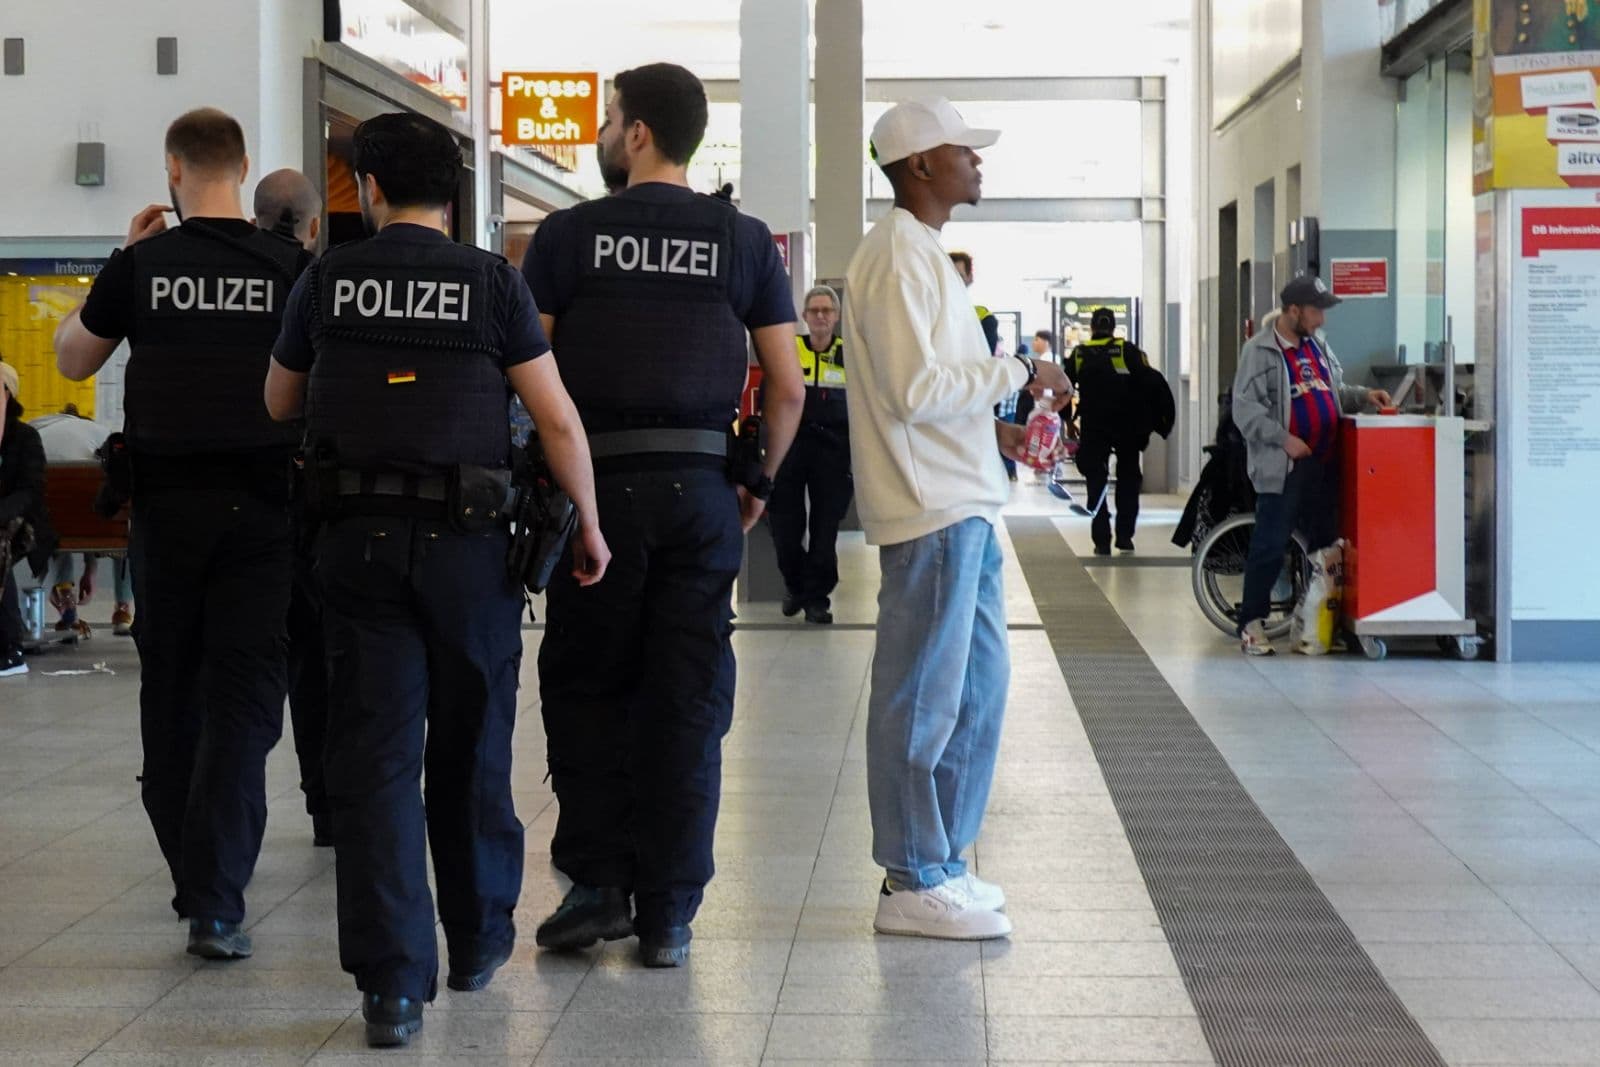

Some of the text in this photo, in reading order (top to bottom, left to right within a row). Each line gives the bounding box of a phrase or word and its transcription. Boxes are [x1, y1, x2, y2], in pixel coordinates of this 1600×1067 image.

[507, 75, 592, 98] Presse
[540, 97, 558, 119] &
[517, 117, 581, 140] Buch
[1532, 224, 1547, 235] DB
[594, 234, 719, 278] POLIZEI
[151, 276, 274, 312] POLIZEI
[333, 278, 470, 322] POLIZEI
